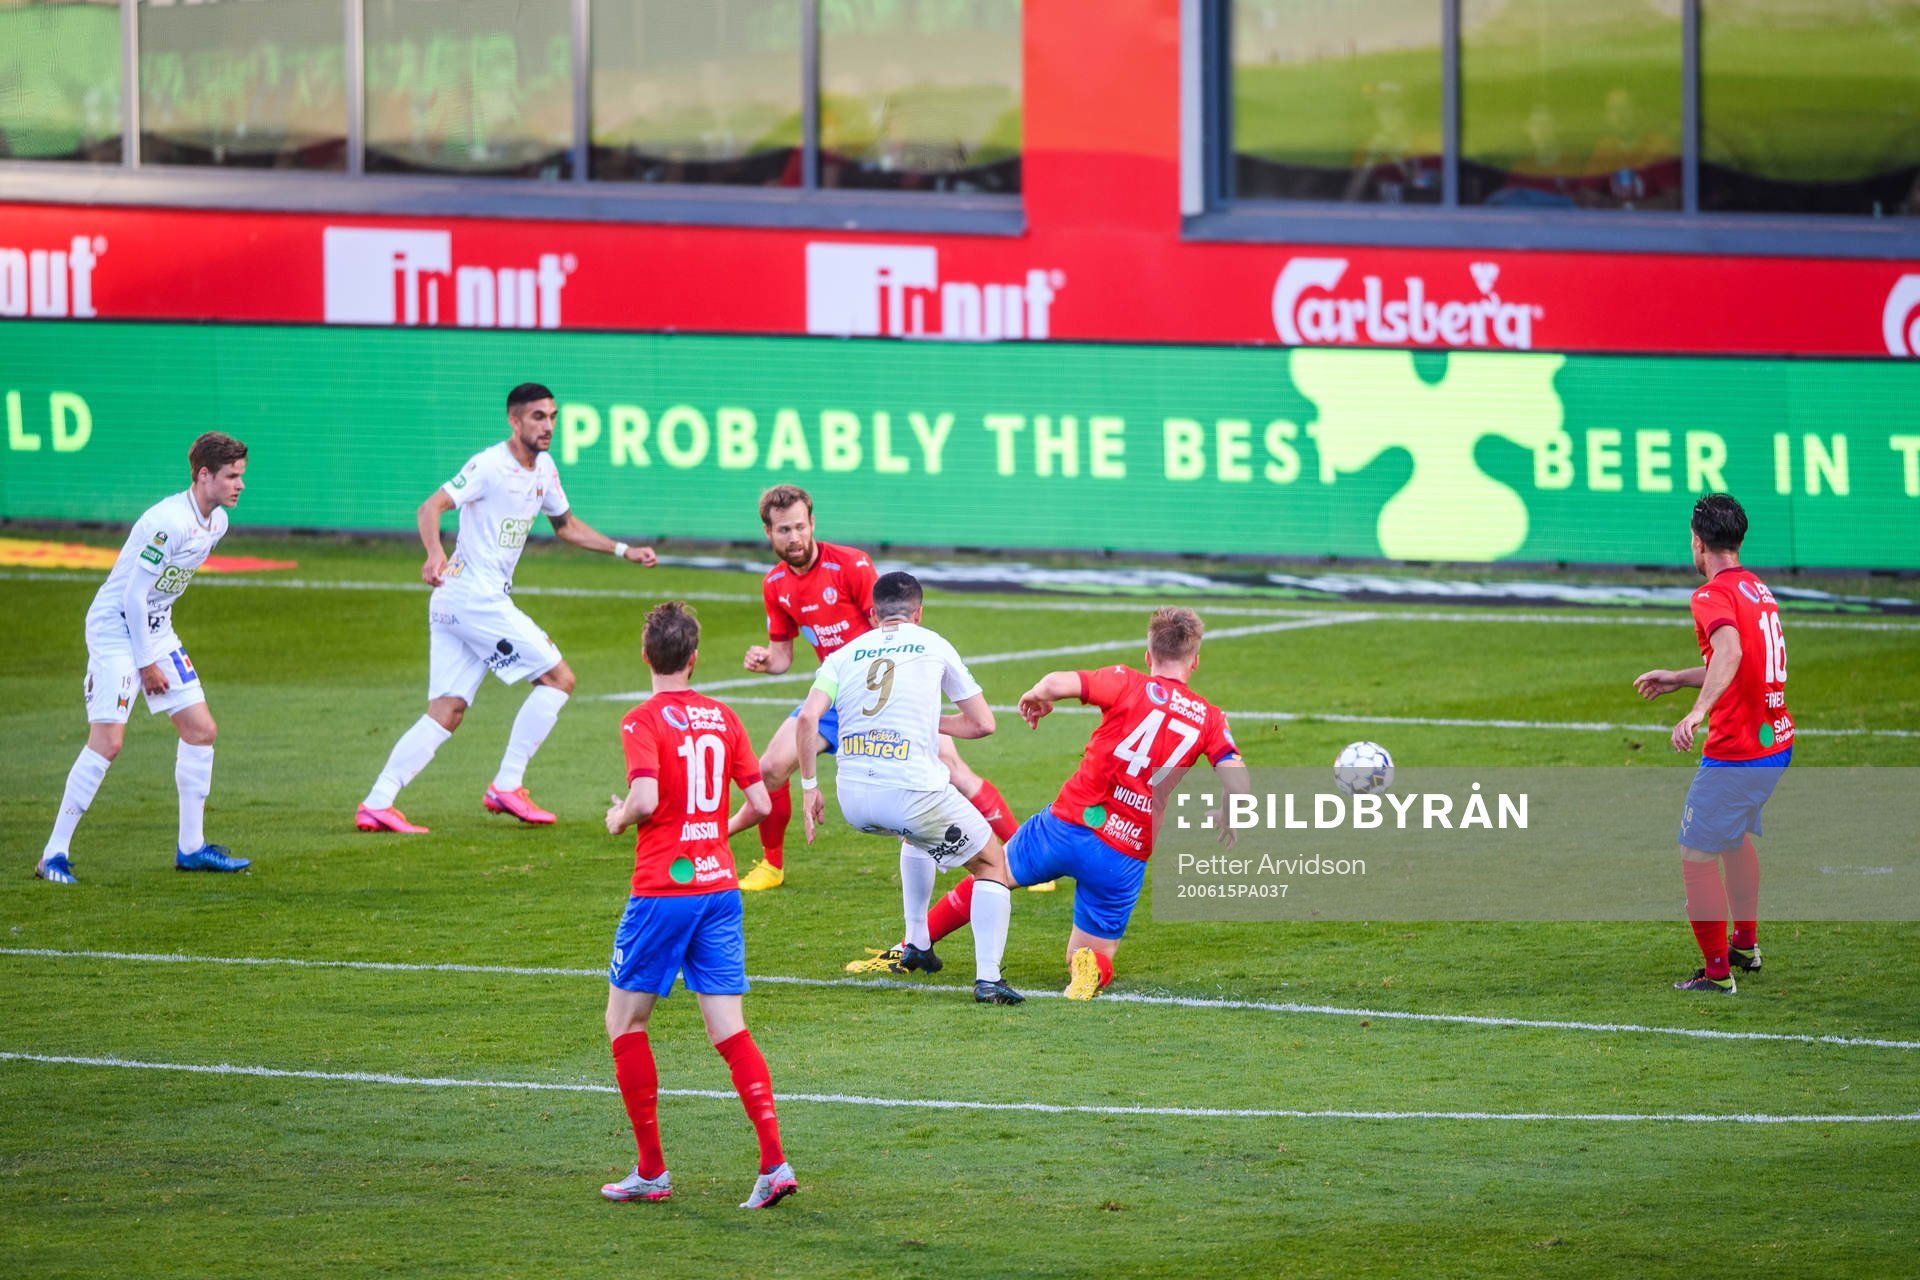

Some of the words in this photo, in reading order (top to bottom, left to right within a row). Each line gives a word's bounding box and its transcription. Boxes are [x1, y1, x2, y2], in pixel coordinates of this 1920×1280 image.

[1271, 257, 1532, 350] Carlsberg
[7, 391, 92, 452] LD
[562, 403, 954, 473] PROBABLY
[985, 414, 1126, 479] THE
[1534, 428, 1728, 493] BEER
[1773, 431, 1850, 496] IN
[813, 620, 850, 636] Resurs
[819, 634, 845, 647] Bank
[1758, 611, 1788, 684] 16
[862, 658, 895, 717] 9
[685, 705, 724, 723] beat
[1171, 688, 1207, 717] beat
[843, 733, 911, 760] Ullared
[1113, 708, 1200, 787] 47
[677, 734, 726, 814] 10
[1107, 813, 1143, 838] Solid
[933, 834, 970, 863] paper
